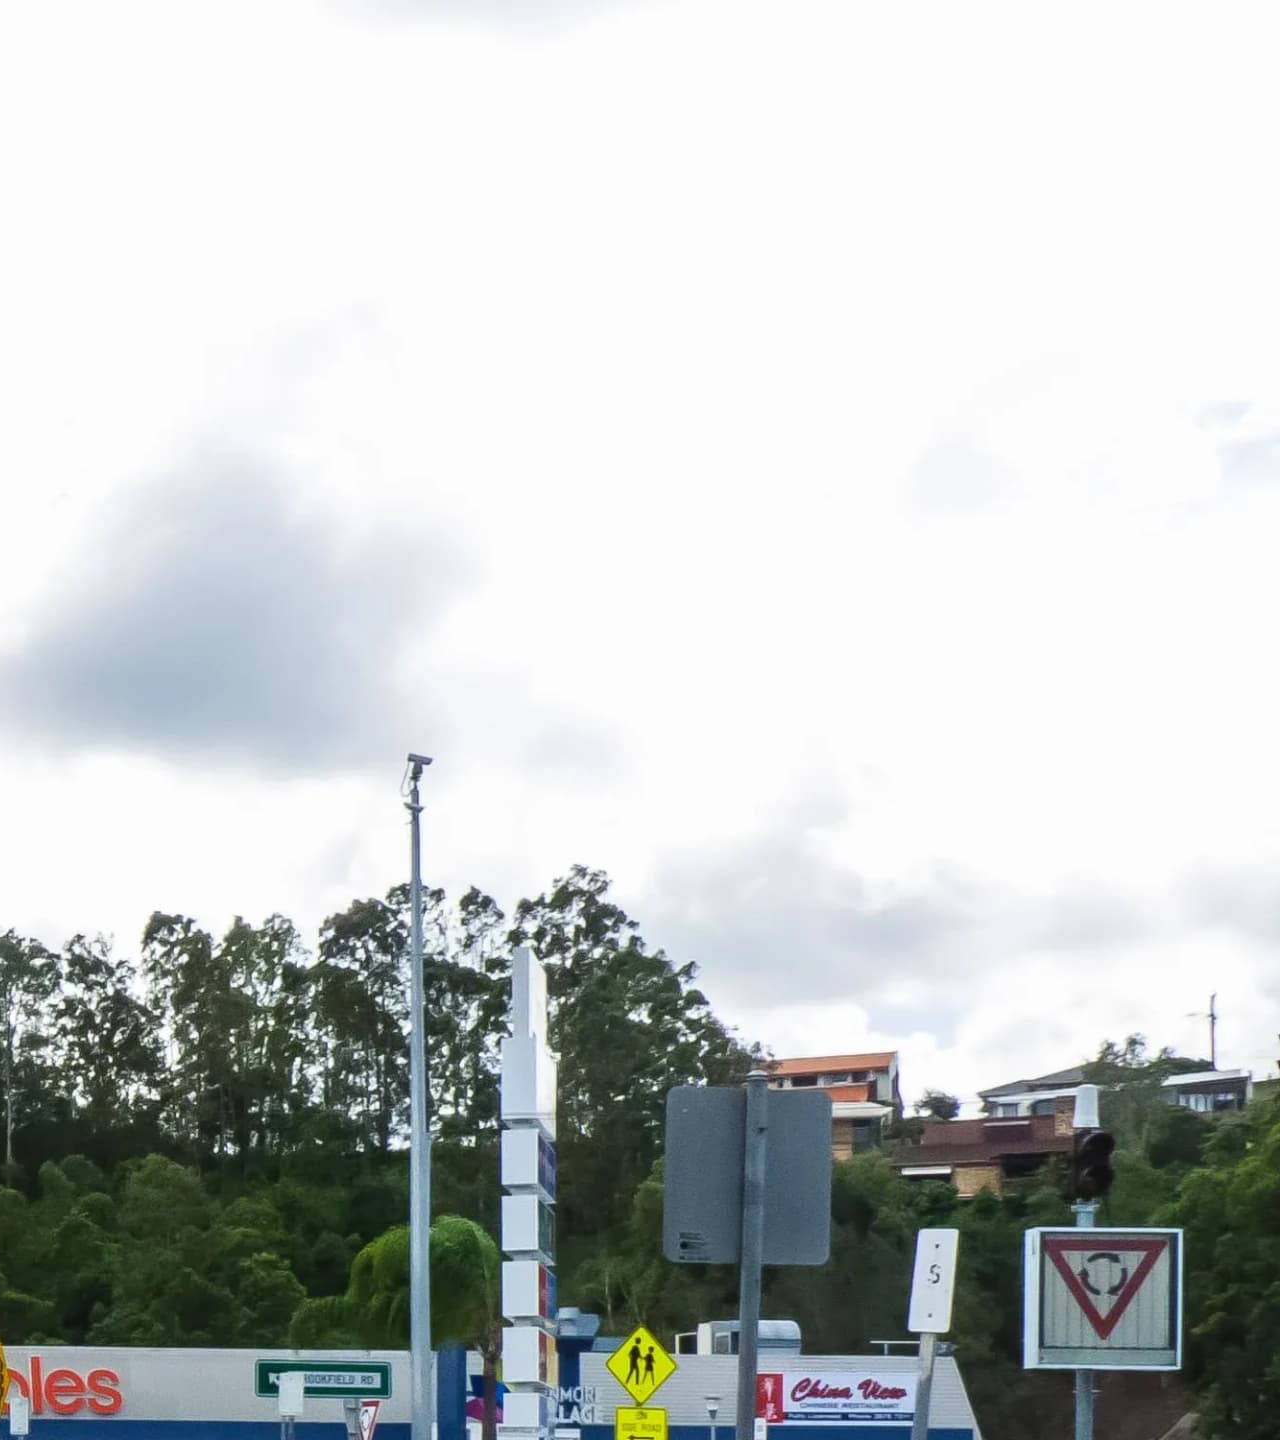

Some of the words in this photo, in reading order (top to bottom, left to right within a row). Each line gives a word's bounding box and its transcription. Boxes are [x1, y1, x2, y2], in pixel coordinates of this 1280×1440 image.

[304, 1374, 355, 1385] OOKFIELD
[790, 1377, 853, 1402] China
[857, 1378, 908, 1400] View
